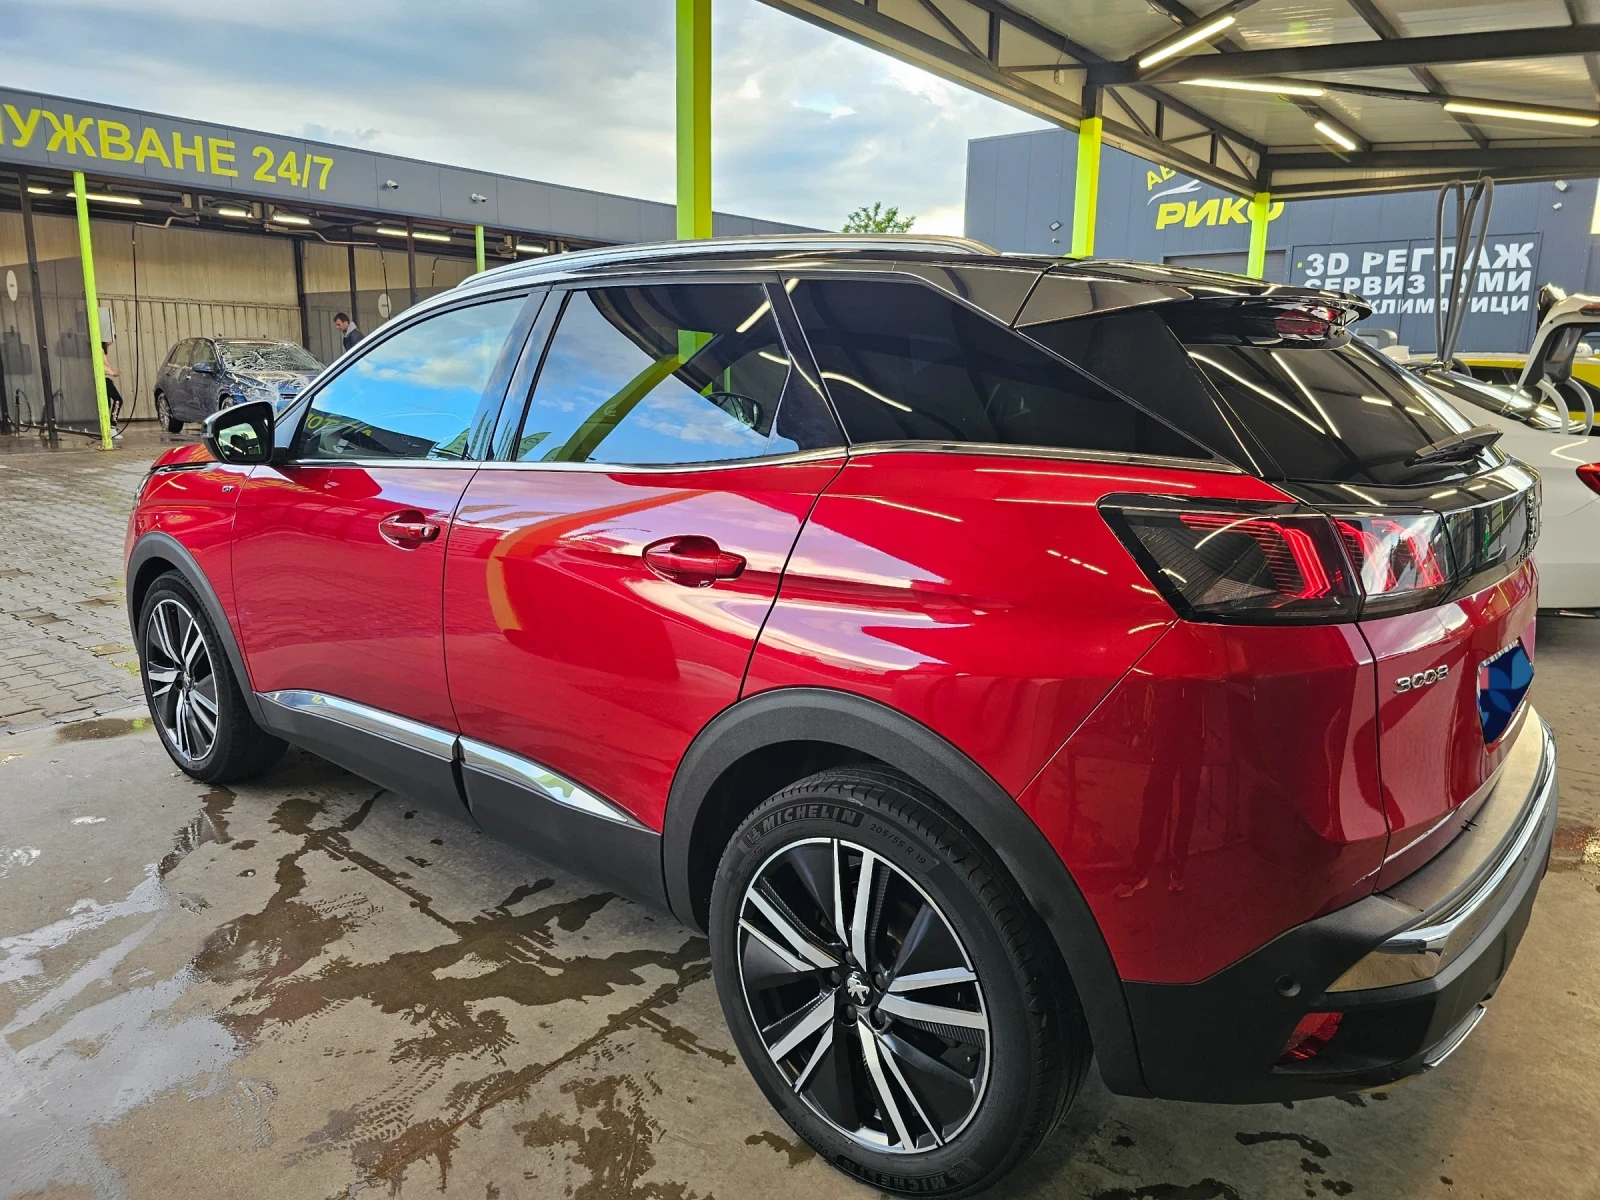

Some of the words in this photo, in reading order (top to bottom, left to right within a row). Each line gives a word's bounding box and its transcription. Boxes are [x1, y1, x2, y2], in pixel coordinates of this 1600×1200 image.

[252, 146, 335, 191] 24/7
[1146, 165, 1177, 191] АВ
[1305, 252, 1350, 277] 3D
[1361, 242, 1535, 274] РЕГЛАЖ
[221, 485, 235, 493] GT
[1393, 664, 1449, 695] 3008
[762, 804, 858, 833] MICHELIN
[870, 823, 906, 848] 205/55
[904, 845, 915, 856] R
[915, 853, 928, 866] 19
[842, 1160, 948, 1191] MICHELIN
